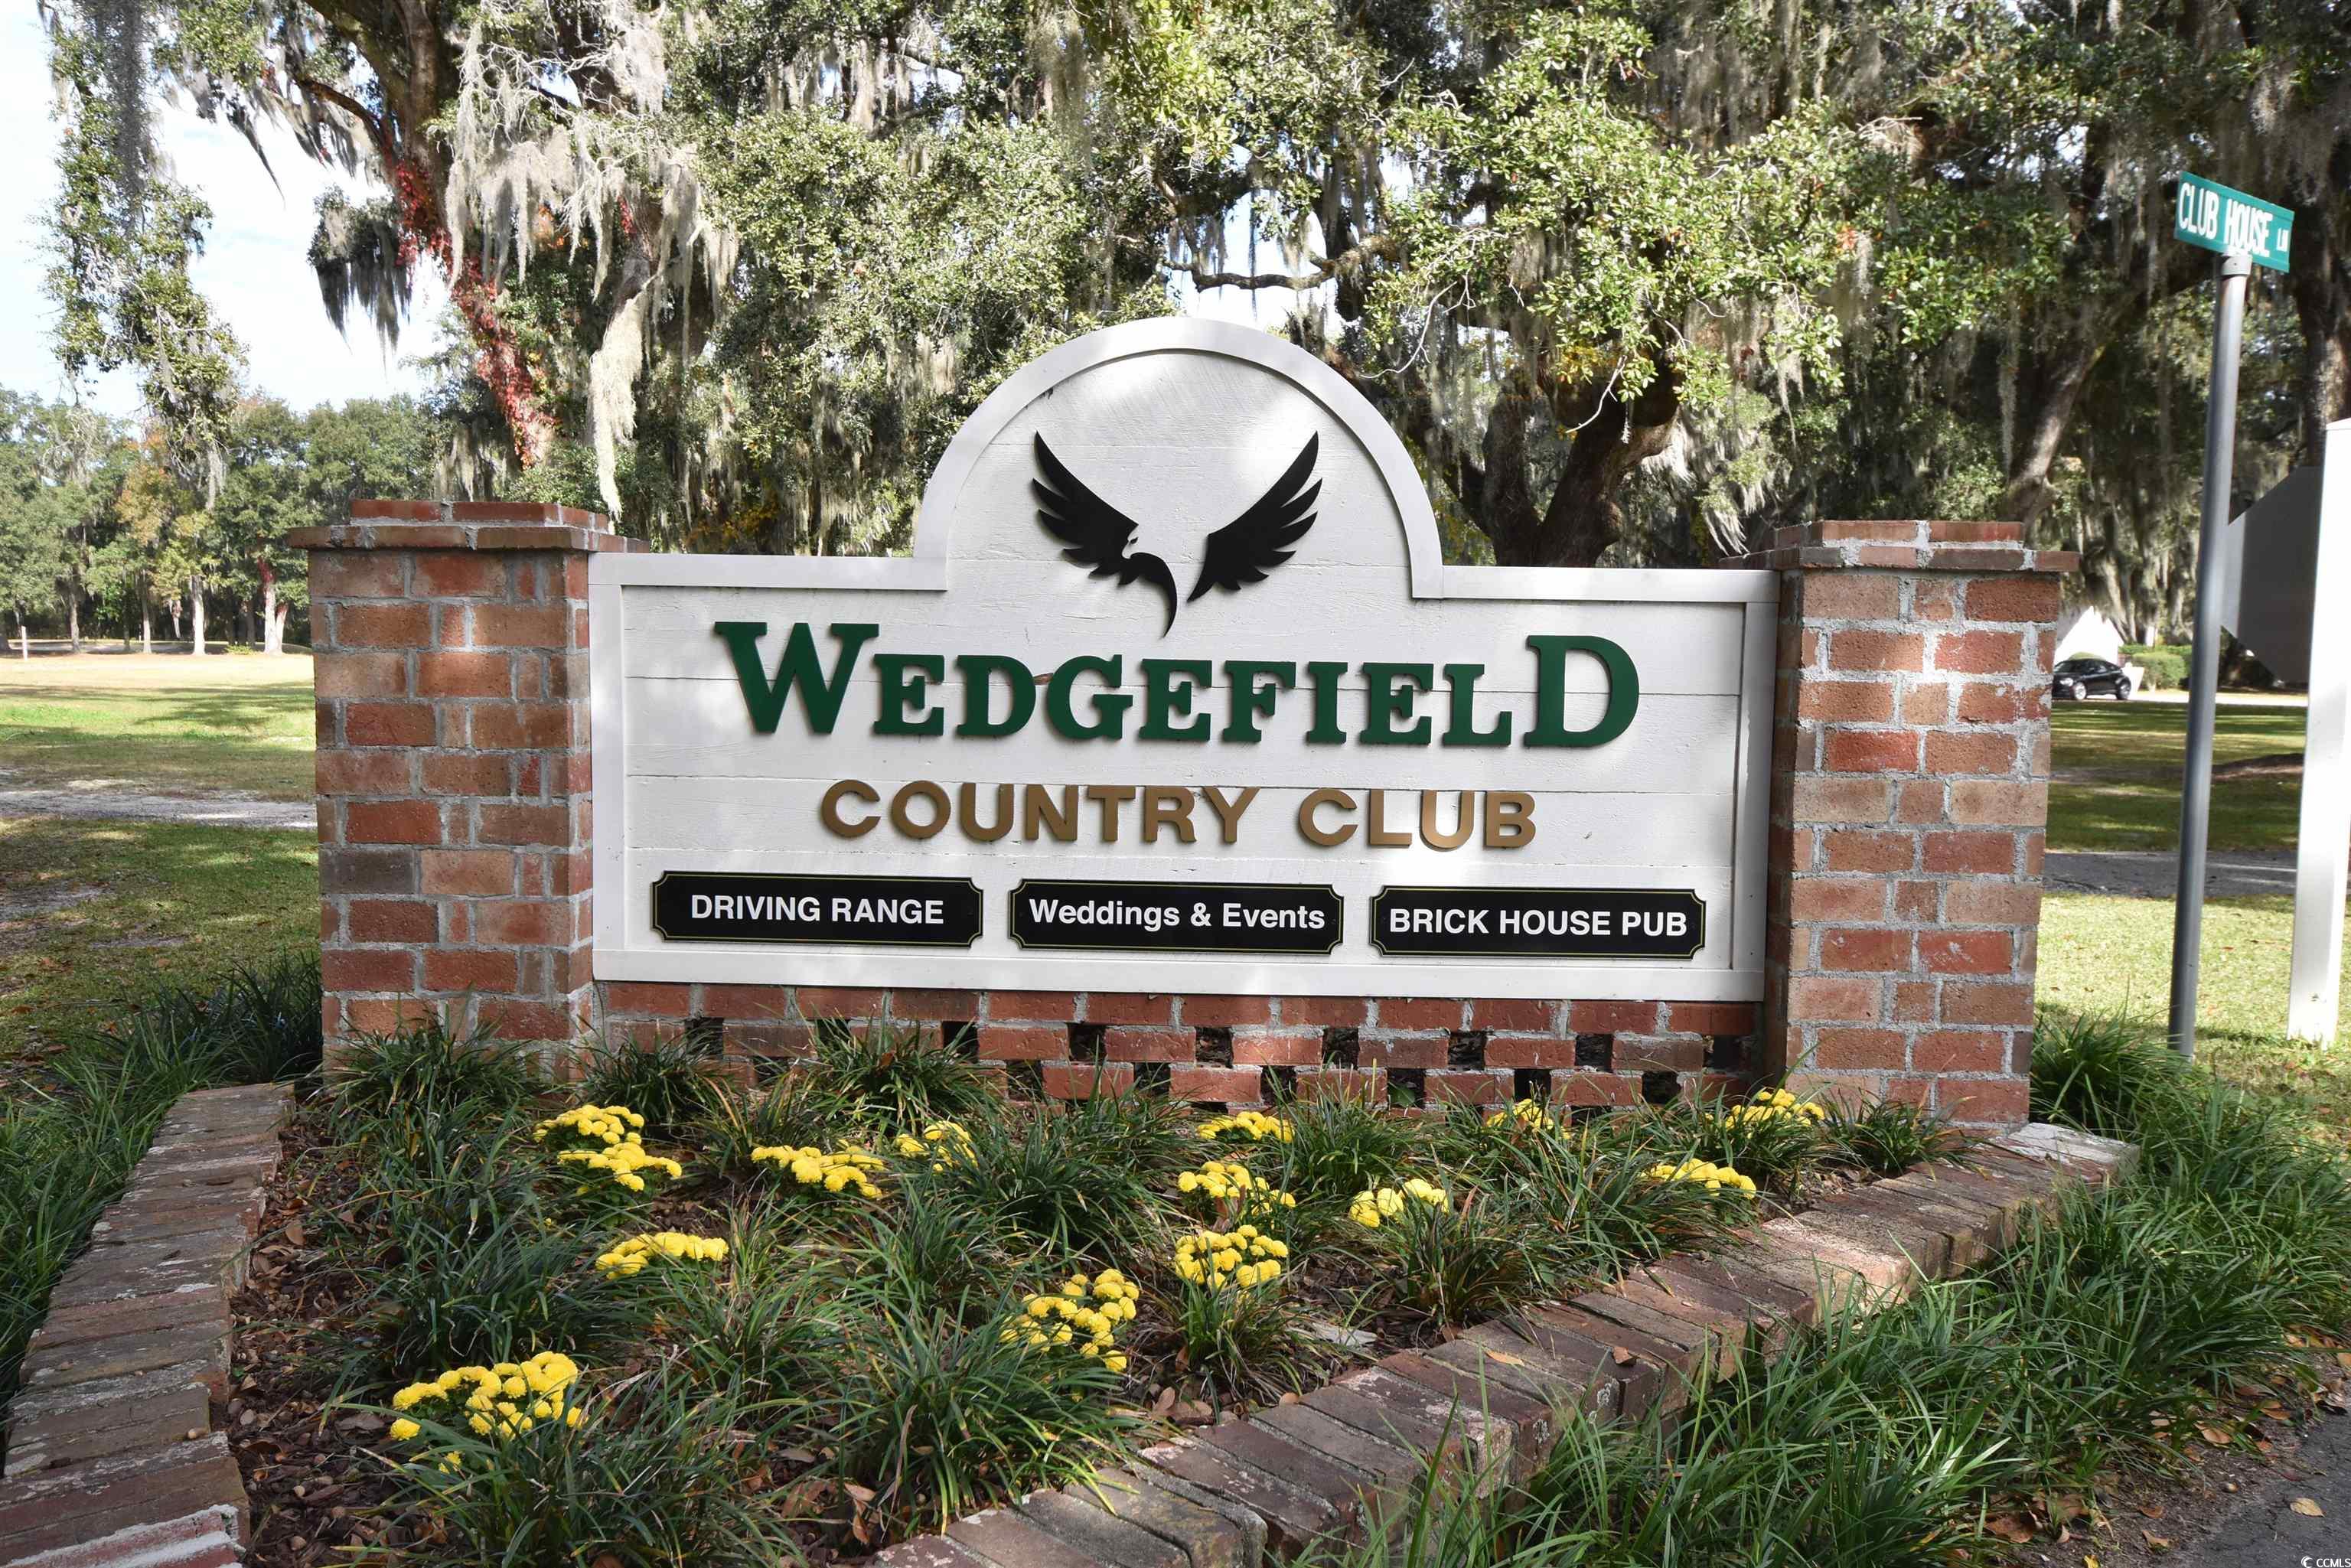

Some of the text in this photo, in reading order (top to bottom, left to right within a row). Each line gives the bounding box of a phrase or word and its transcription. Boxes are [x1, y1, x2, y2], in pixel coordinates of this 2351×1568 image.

[2178, 182, 2289, 258] CLUB HOUSE LN
[715, 621, 1640, 747] WEDGEFIELD
[820, 780, 1537, 850] COUNTRY CLUB
[692, 895, 944, 924] DRIVING RANGE
[1029, 898, 1325, 932] Weddings & Events
[1390, 908, 1687, 937] BRICK HOUSE PUB
